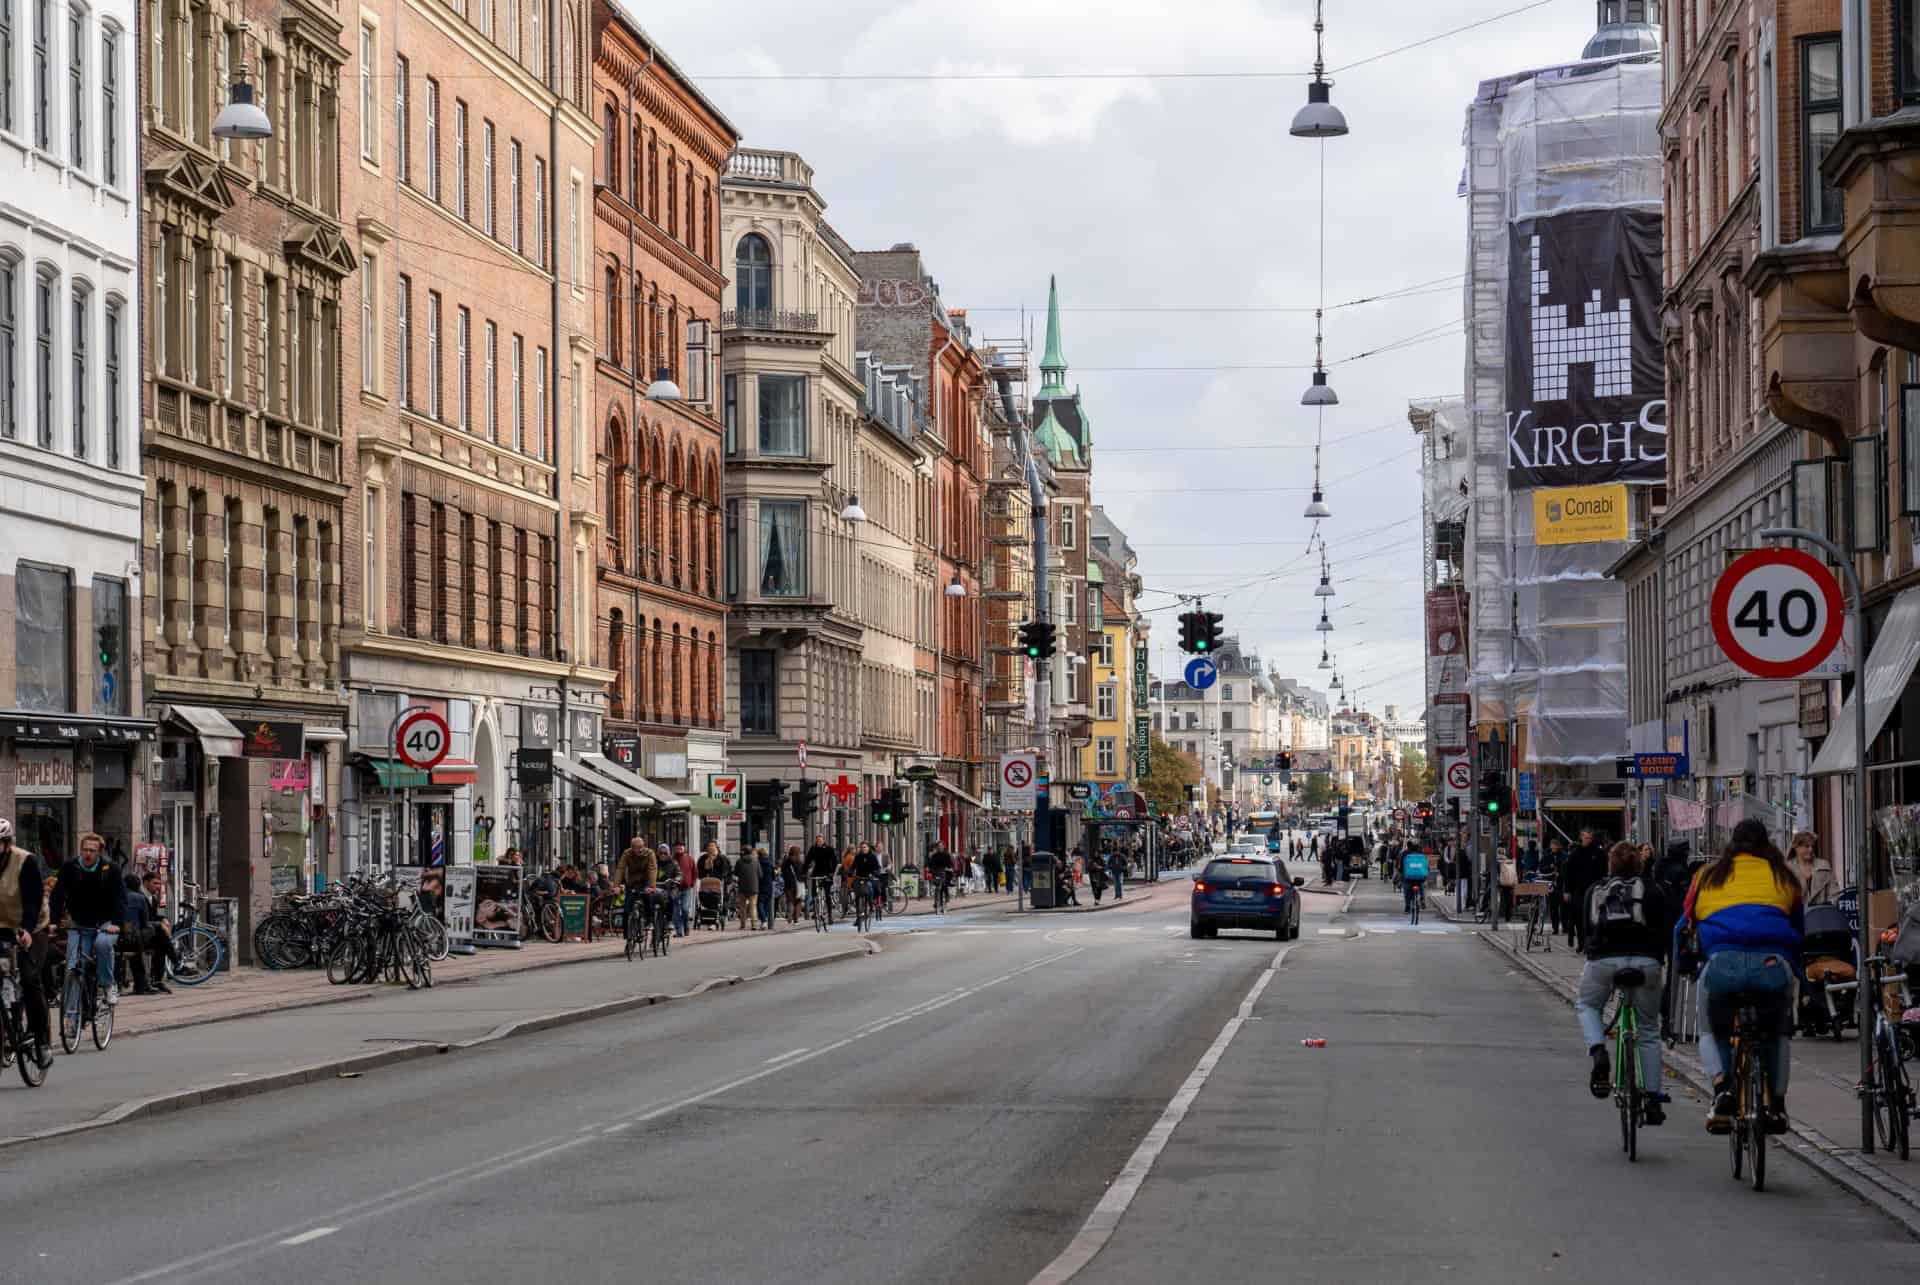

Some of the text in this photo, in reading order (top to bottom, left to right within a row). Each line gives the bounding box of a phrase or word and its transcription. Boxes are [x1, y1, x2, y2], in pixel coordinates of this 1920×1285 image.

[1565, 496, 1613, 515] Conabi
[1734, 588, 1817, 637] 40
[406, 730, 440, 752] 40
[16, 756, 73, 786] TEMPLE BAR
[1638, 756, 1677, 767] CASINO
[1640, 765, 1676, 775] HOUSE
